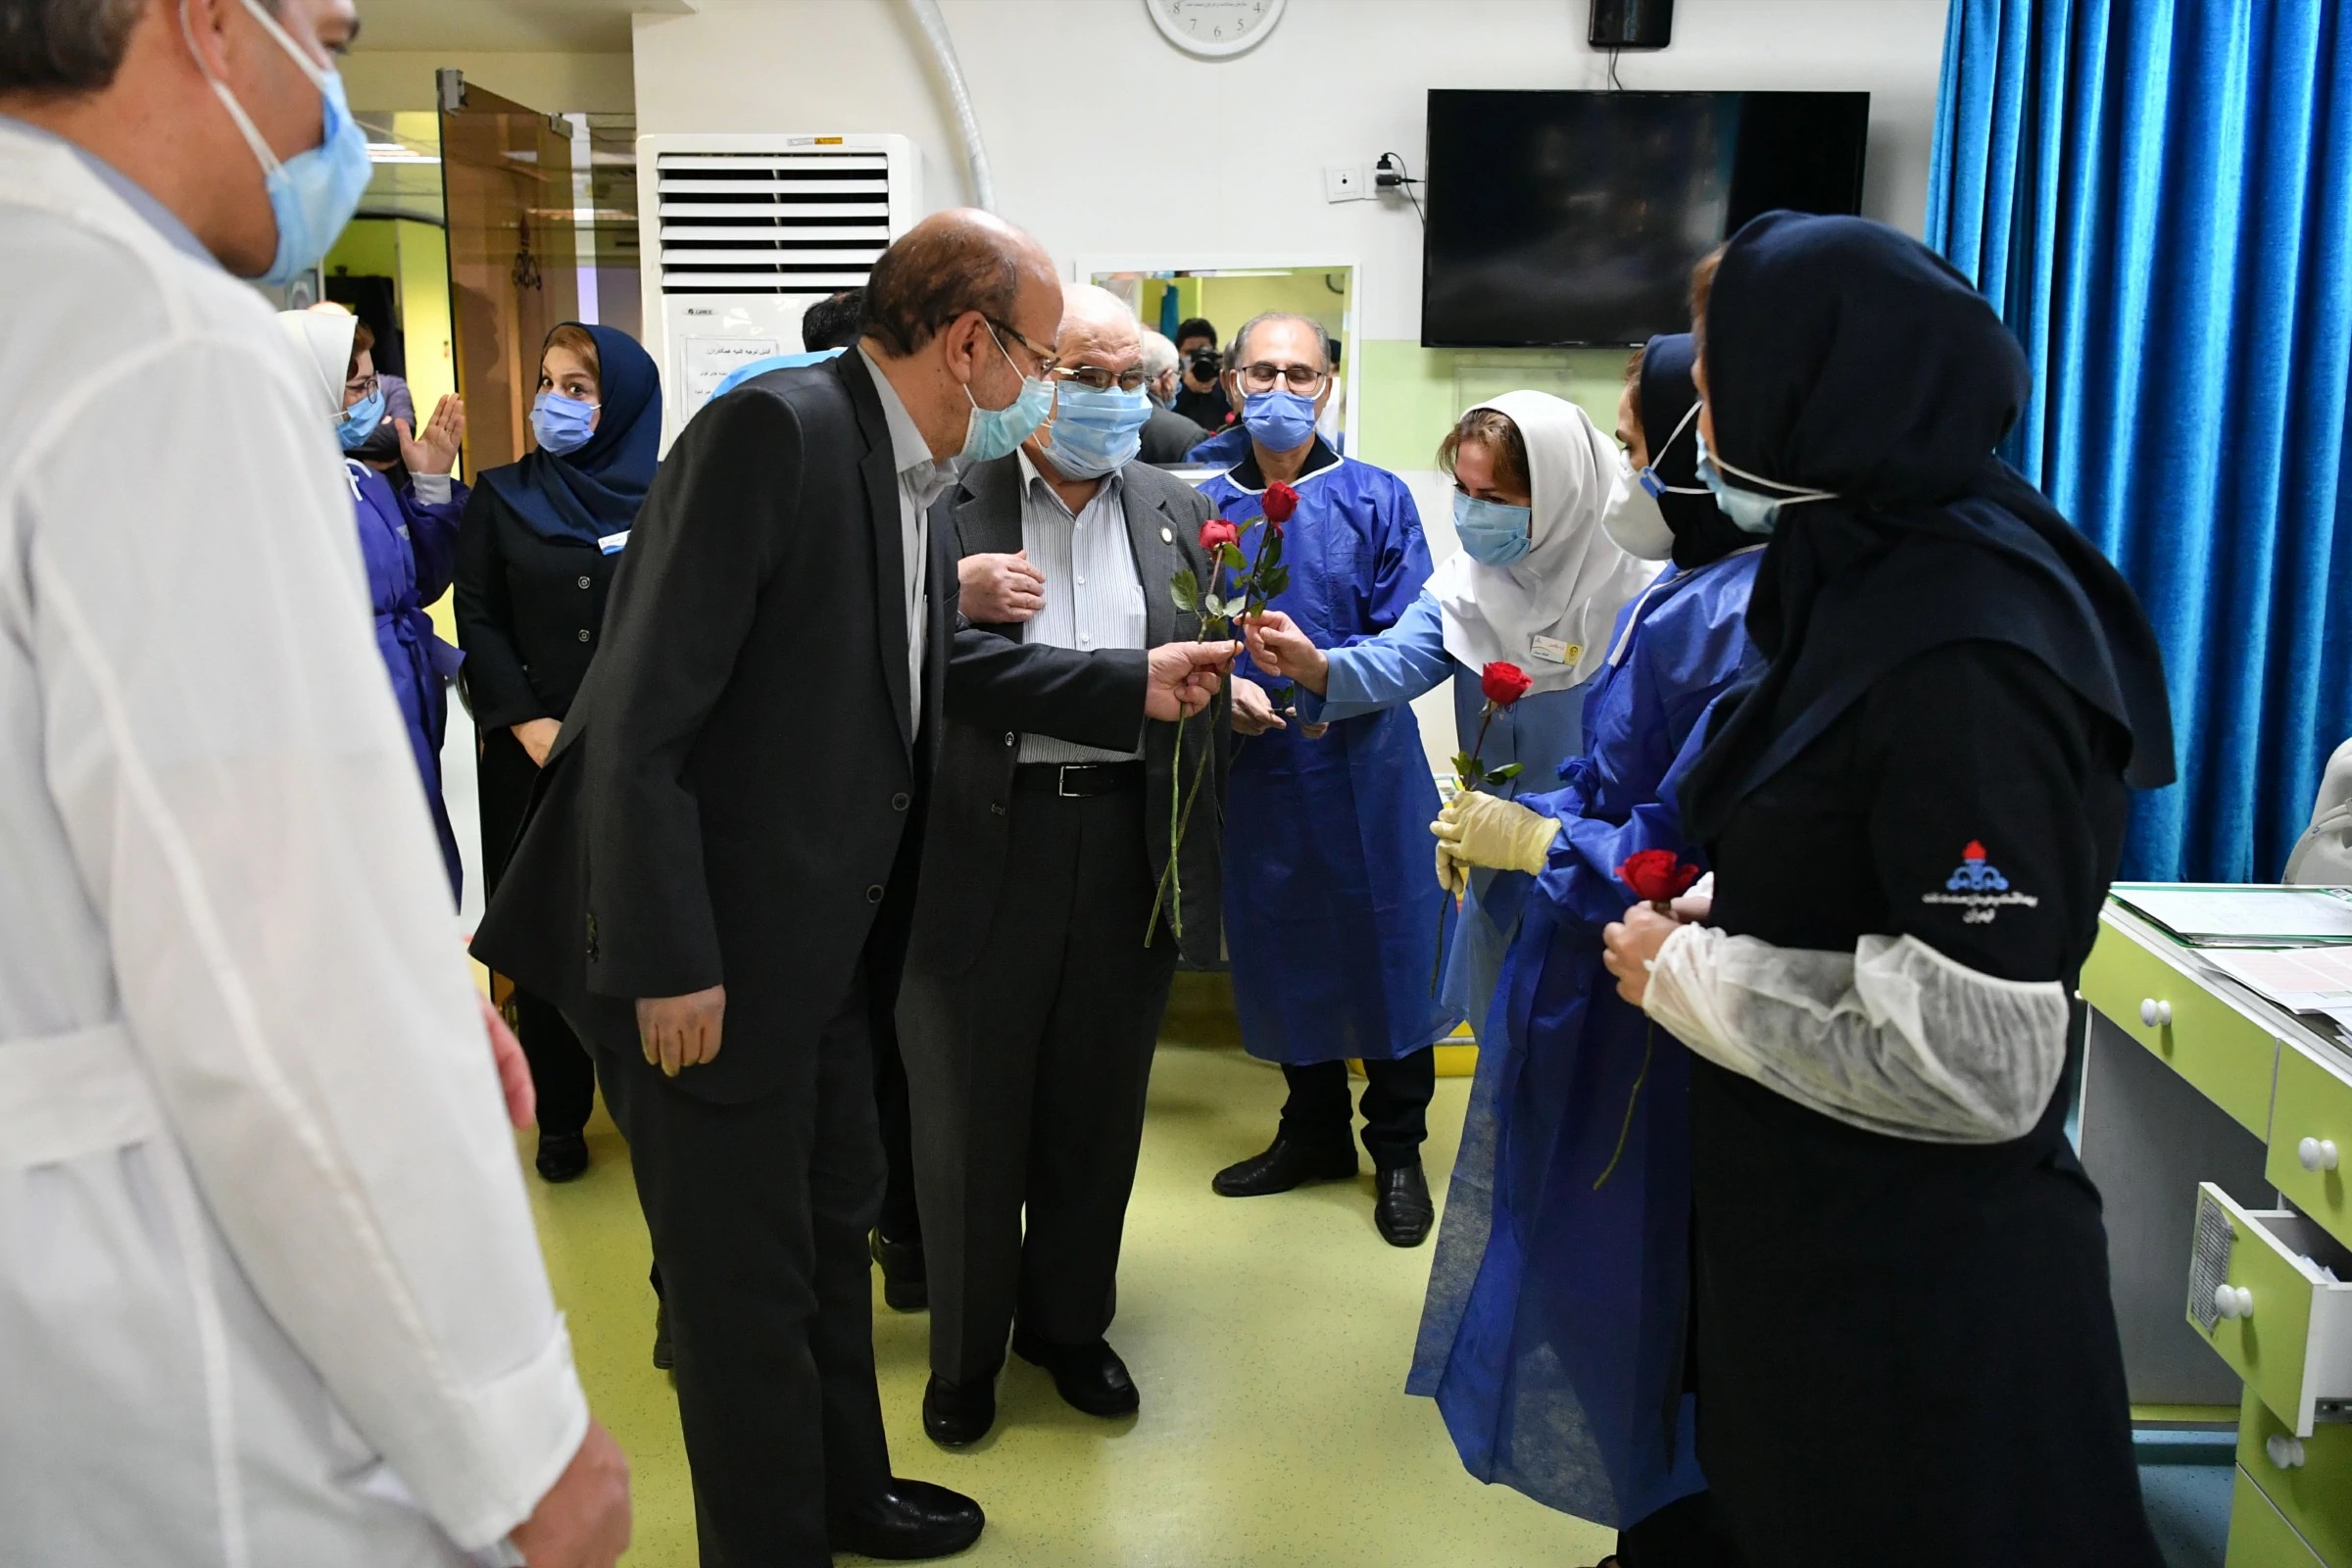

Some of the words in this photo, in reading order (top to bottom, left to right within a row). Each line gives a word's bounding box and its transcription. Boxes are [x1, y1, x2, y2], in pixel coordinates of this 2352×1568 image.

[1173, 2, 1181, 15] 8
[1253, 2, 1261, 14] 4
[1190, 18, 1198, 30] 7
[1237, 19, 1245, 31] 5
[1213, 24, 1222, 37] 6
